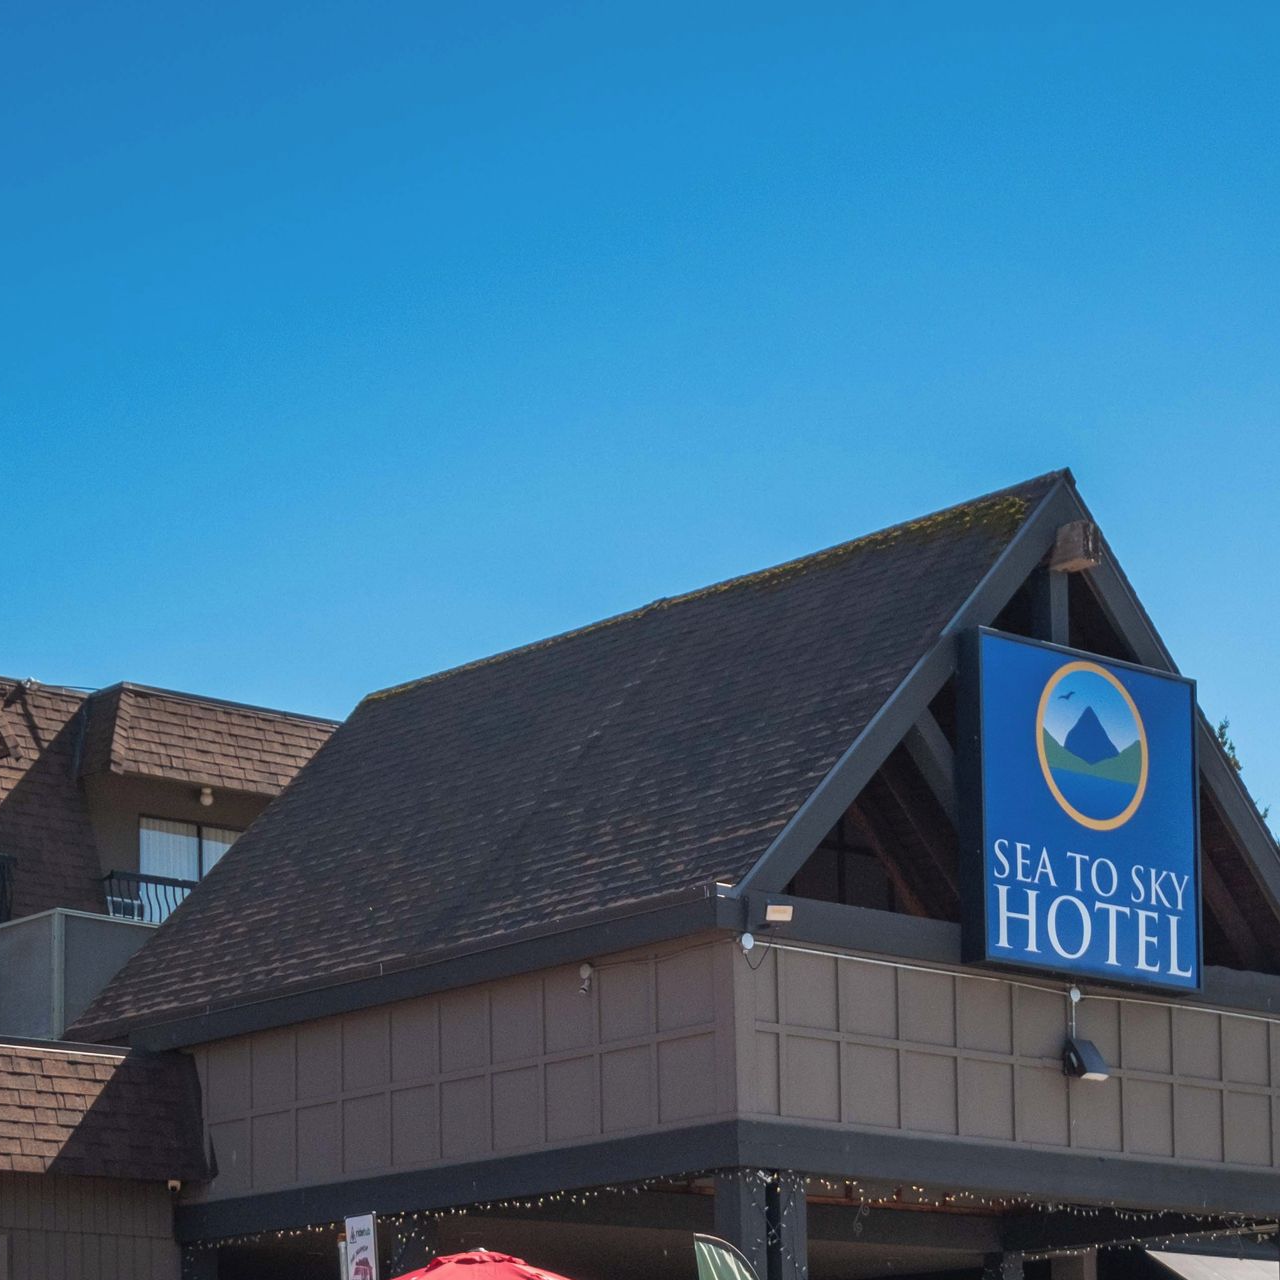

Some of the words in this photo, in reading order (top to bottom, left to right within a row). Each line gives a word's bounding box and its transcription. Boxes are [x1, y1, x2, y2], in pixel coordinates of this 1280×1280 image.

[993, 838, 1057, 888] SEA
[1066, 851, 1118, 897] TO
[1131, 865, 1189, 911] SKY
[993, 883, 1193, 978] HOTEL
